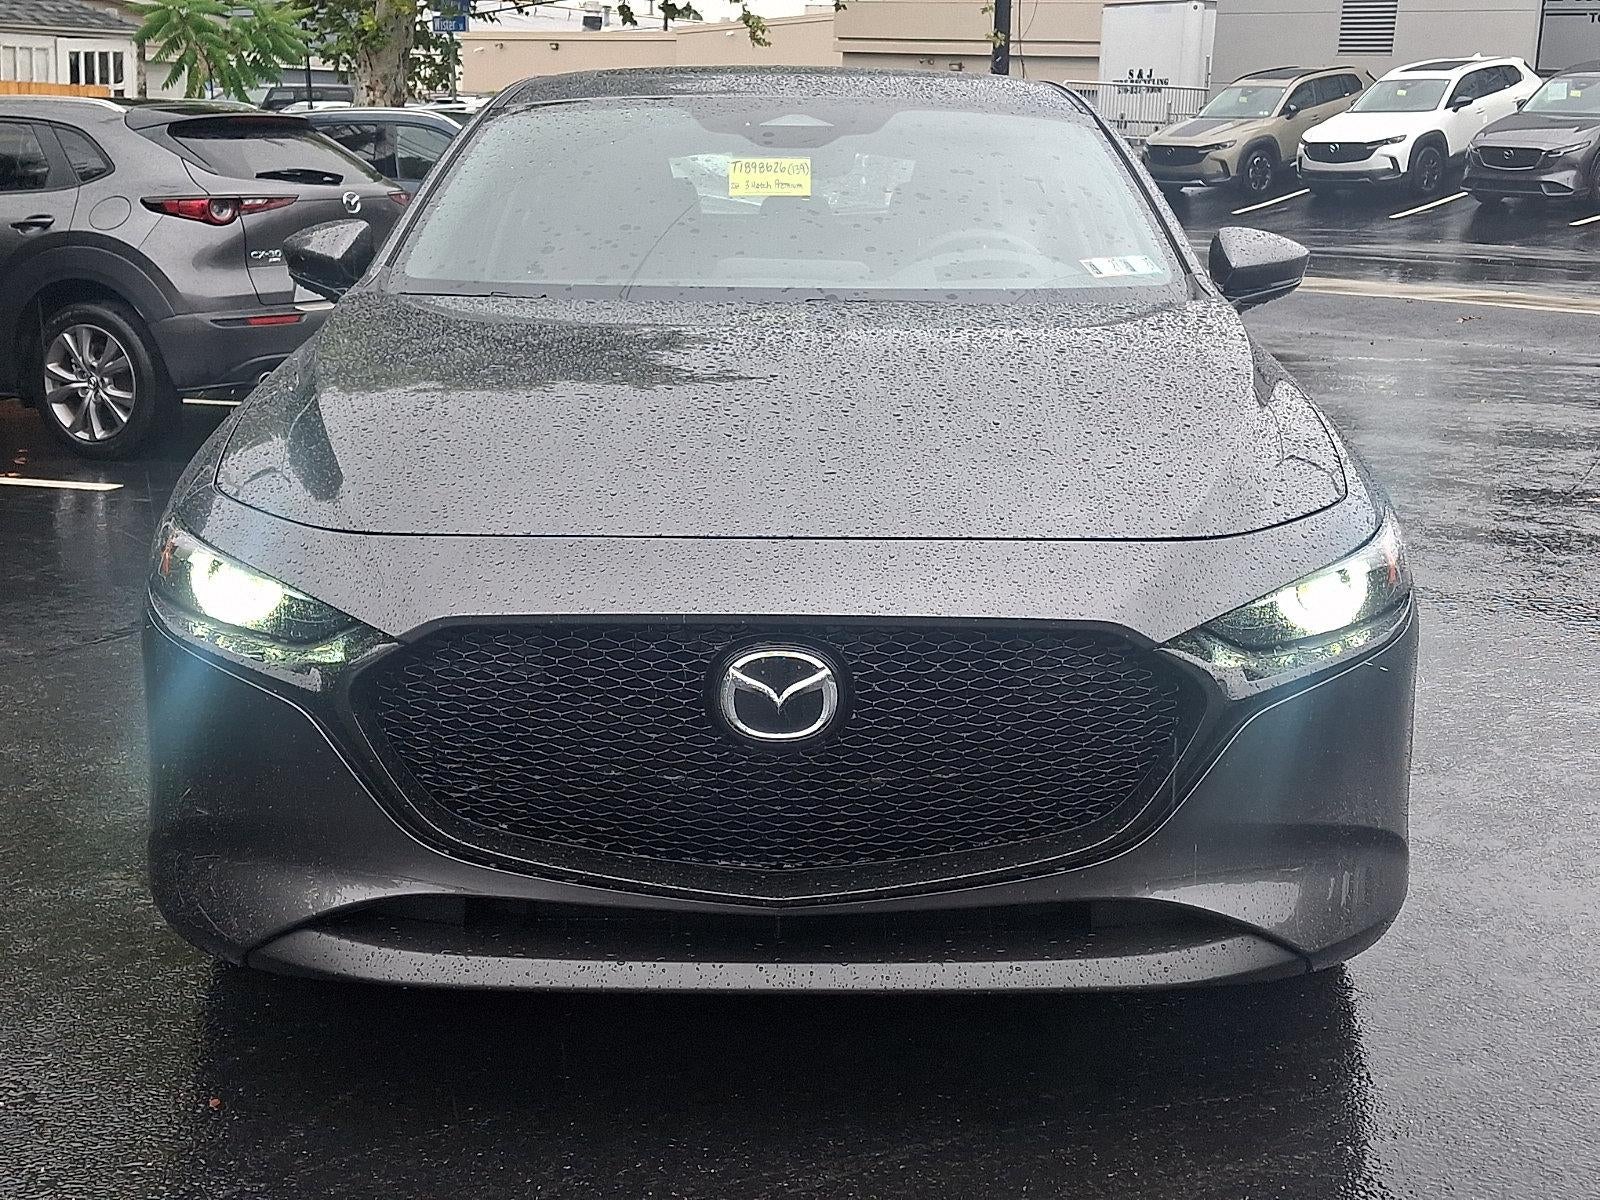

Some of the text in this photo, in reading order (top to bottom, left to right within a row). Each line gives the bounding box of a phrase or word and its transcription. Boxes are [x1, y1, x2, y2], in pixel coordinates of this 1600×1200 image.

[434, 17, 456, 31] Wister
[1127, 68, 1134, 79] S
[1146, 68, 1153, 79] J
[774, 178, 803, 190] Premium
[250, 249, 282, 259] CX-30
